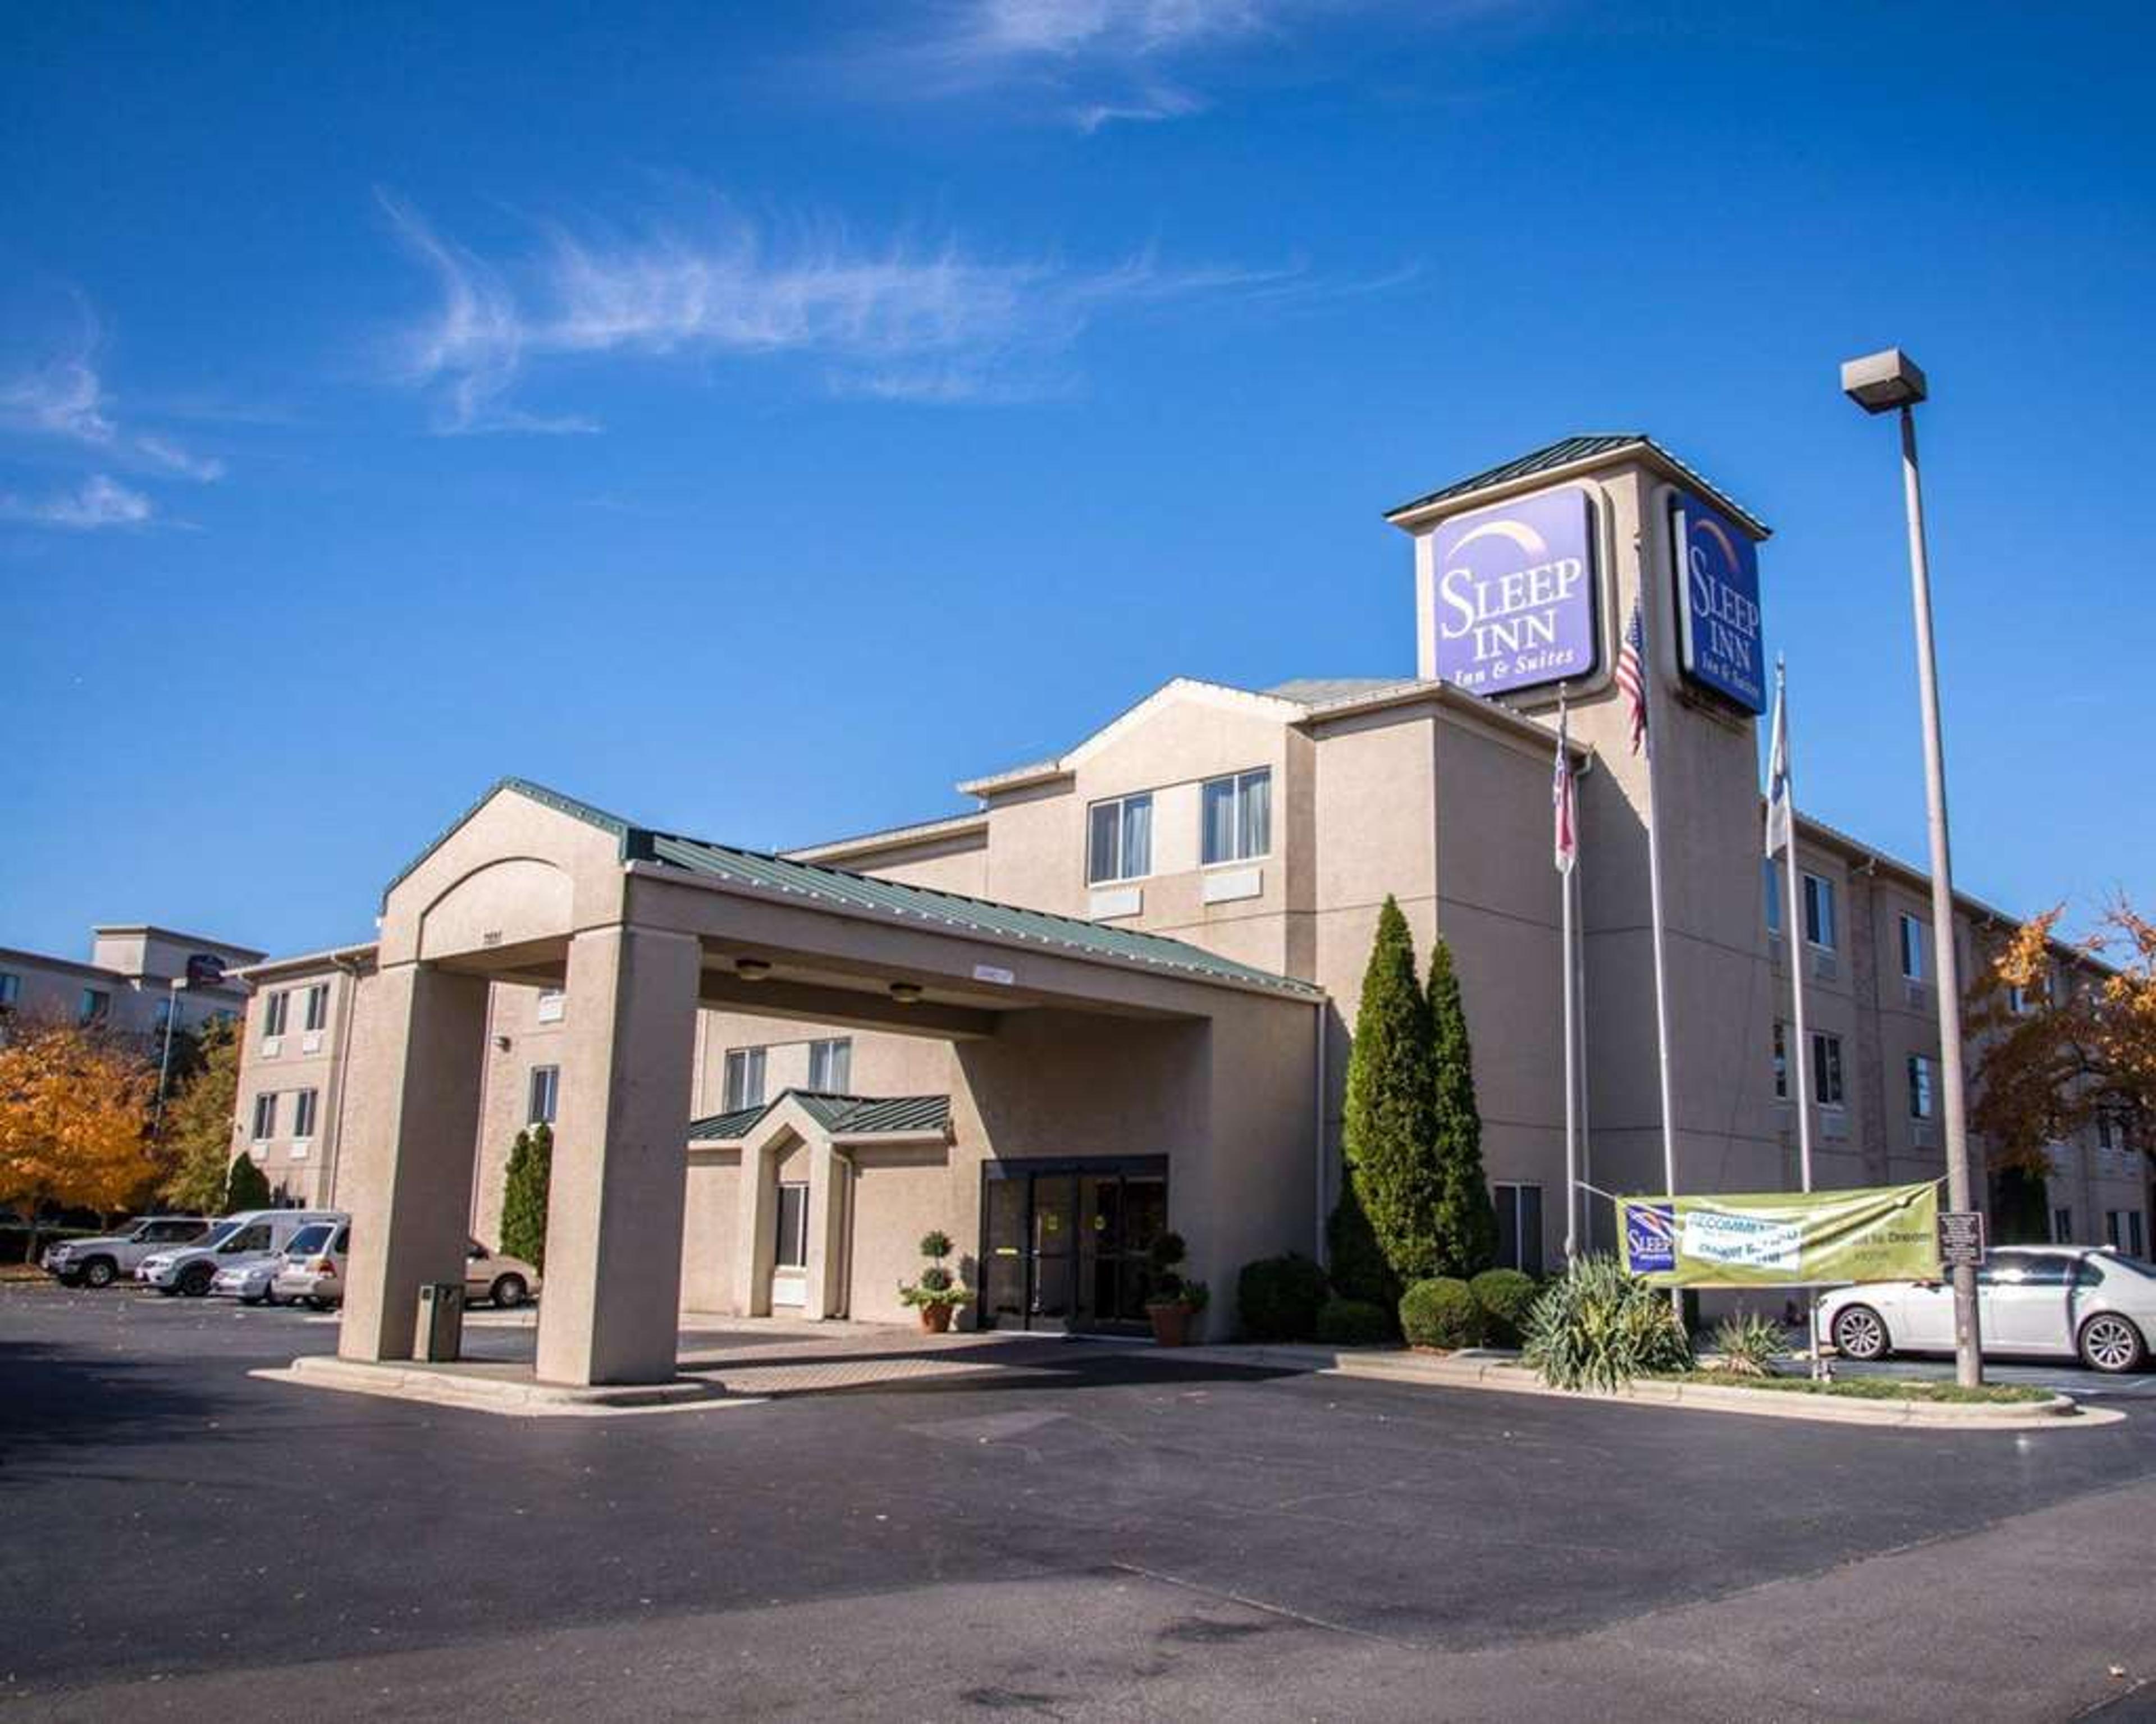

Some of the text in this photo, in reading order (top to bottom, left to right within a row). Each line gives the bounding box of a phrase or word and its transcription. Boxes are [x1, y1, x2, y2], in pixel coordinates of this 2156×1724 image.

[1440, 557, 1582, 639] SLEEP
[1690, 546, 1759, 639] SLEEP
[1473, 609, 1558, 661] INN
[1710, 619, 1752, 674] INN
[1455, 649, 1574, 685] Inn & Suites
